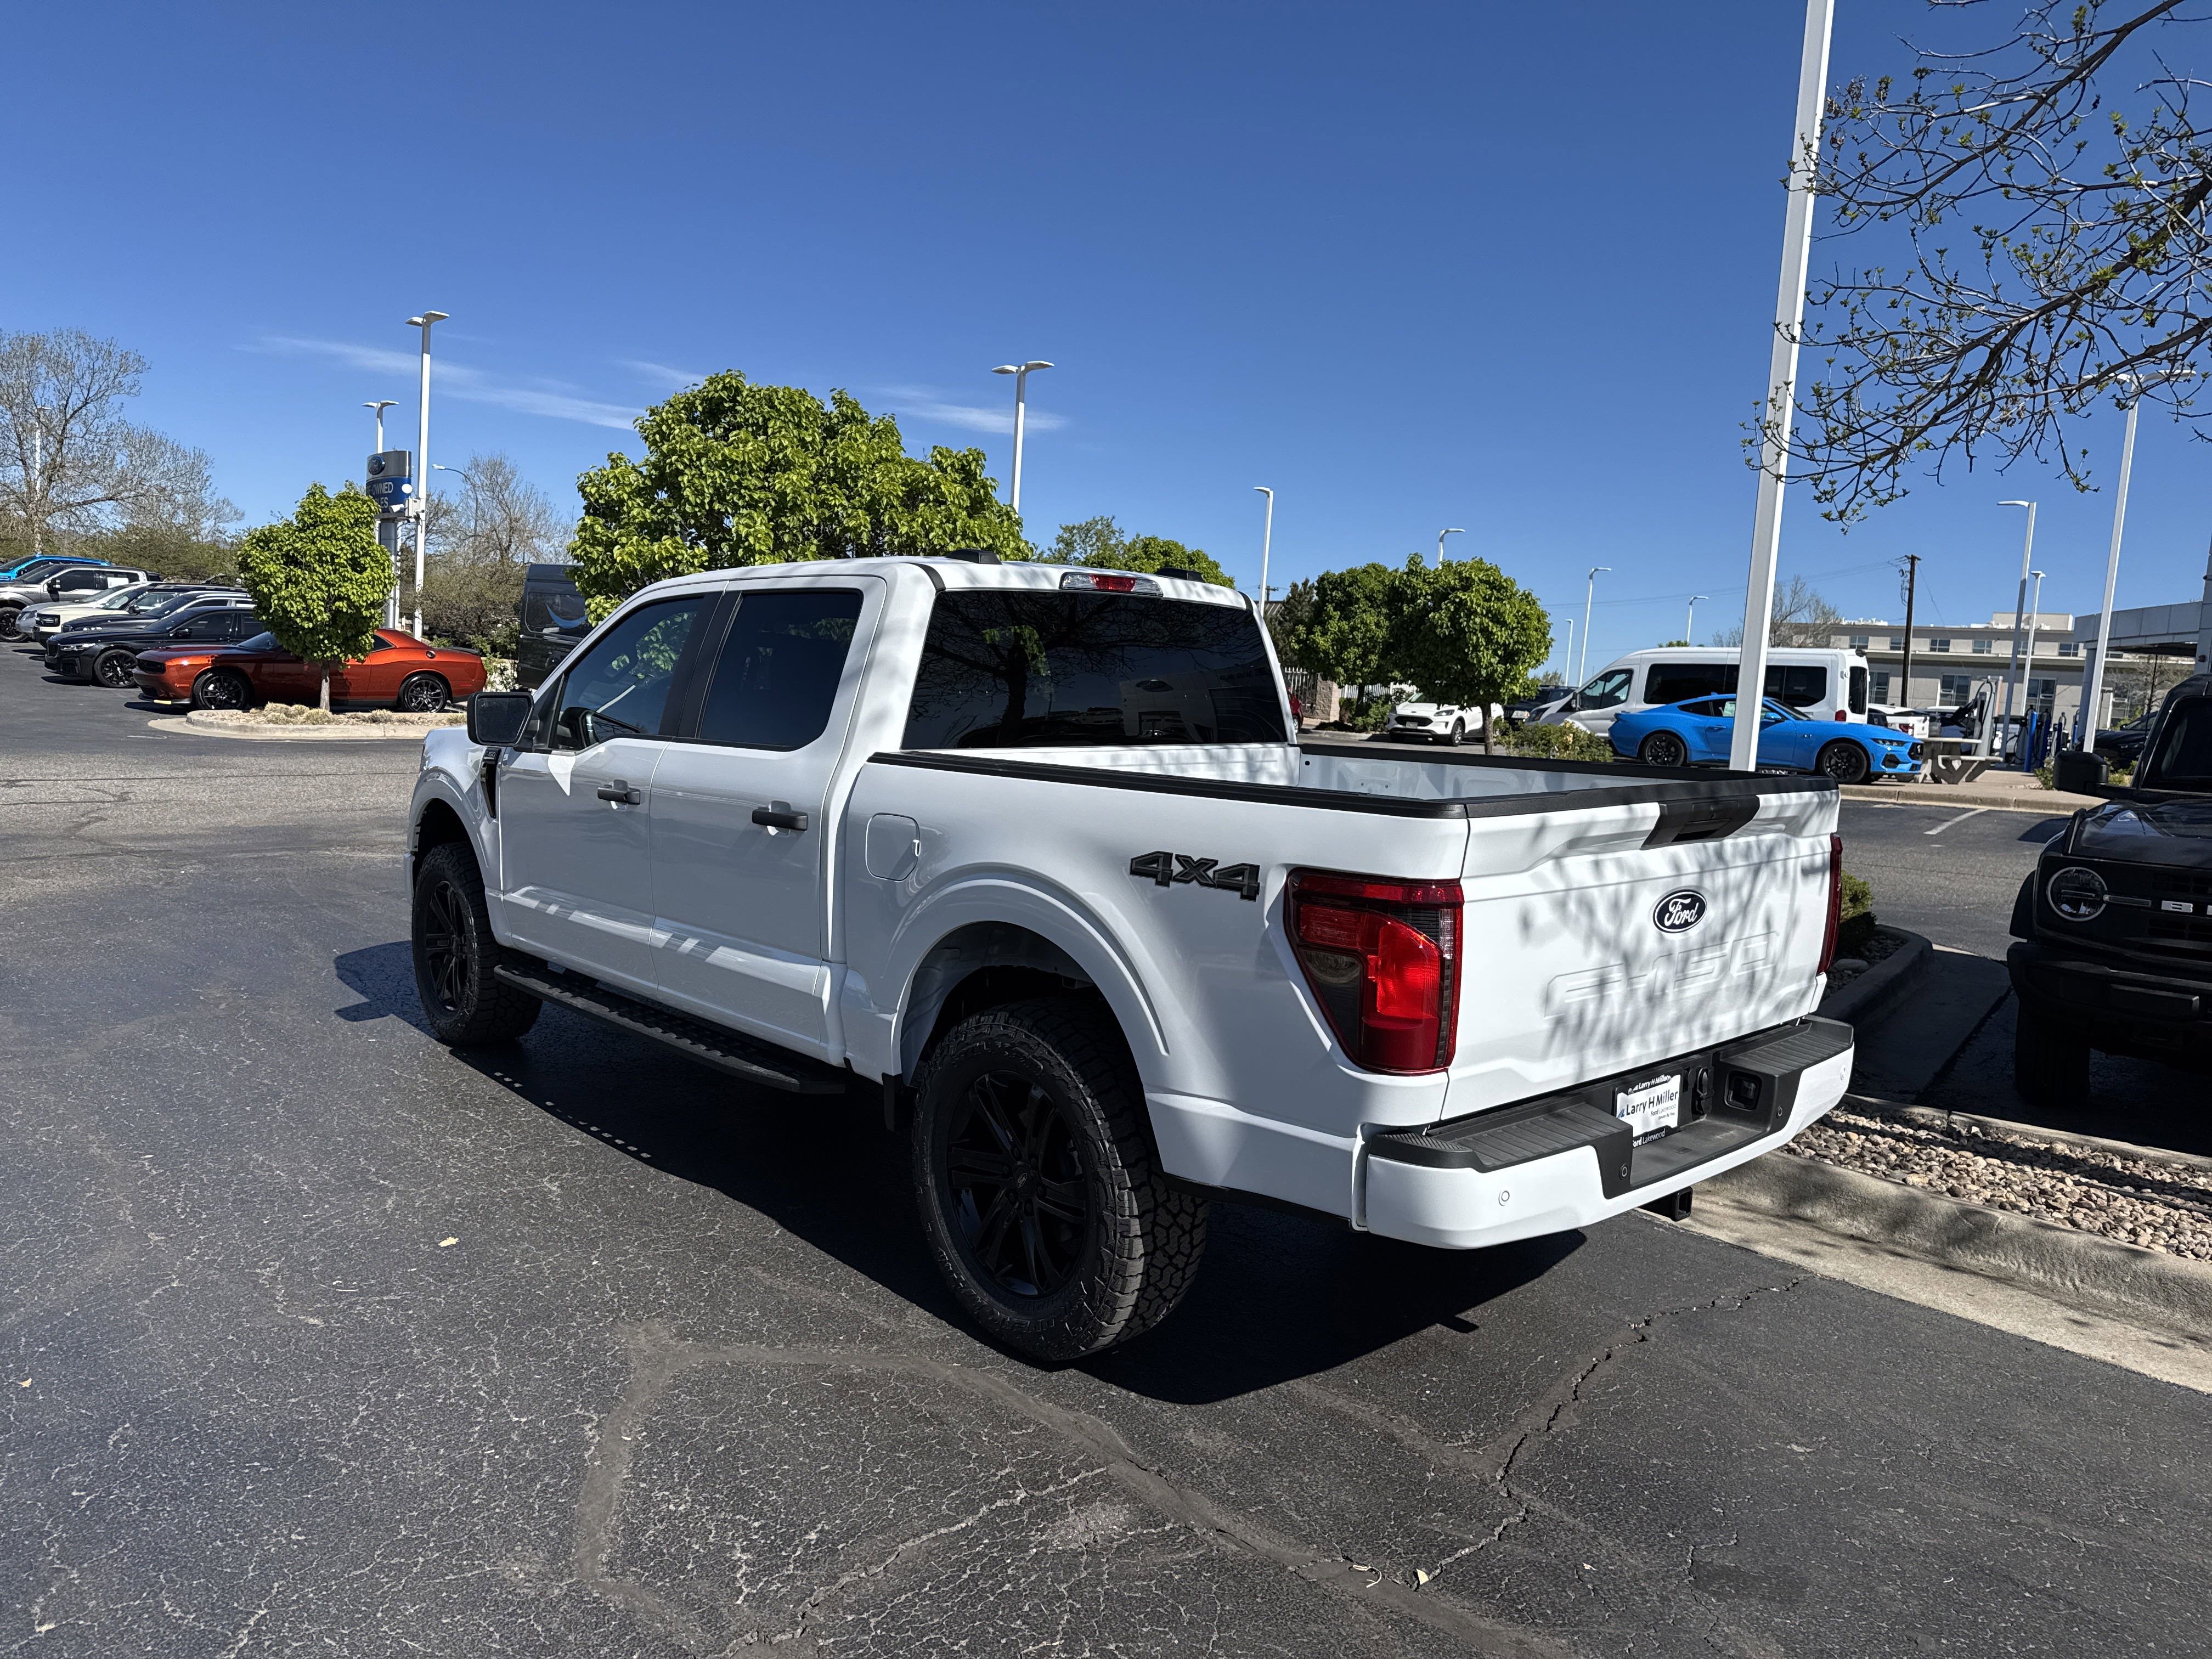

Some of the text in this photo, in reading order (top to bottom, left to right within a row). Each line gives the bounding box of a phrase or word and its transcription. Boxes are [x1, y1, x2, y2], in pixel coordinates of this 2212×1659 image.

[1664, 898, 1699, 927] Ford
[1638, 1081, 1651, 1090] Larry
[1655, 1074, 1671, 1084] Miller
[1626, 1090, 1678, 1116] Larry H Miller
[1651, 1108, 1659, 1116] Ford
[1633, 1128, 1666, 1148] ord Lakewood
